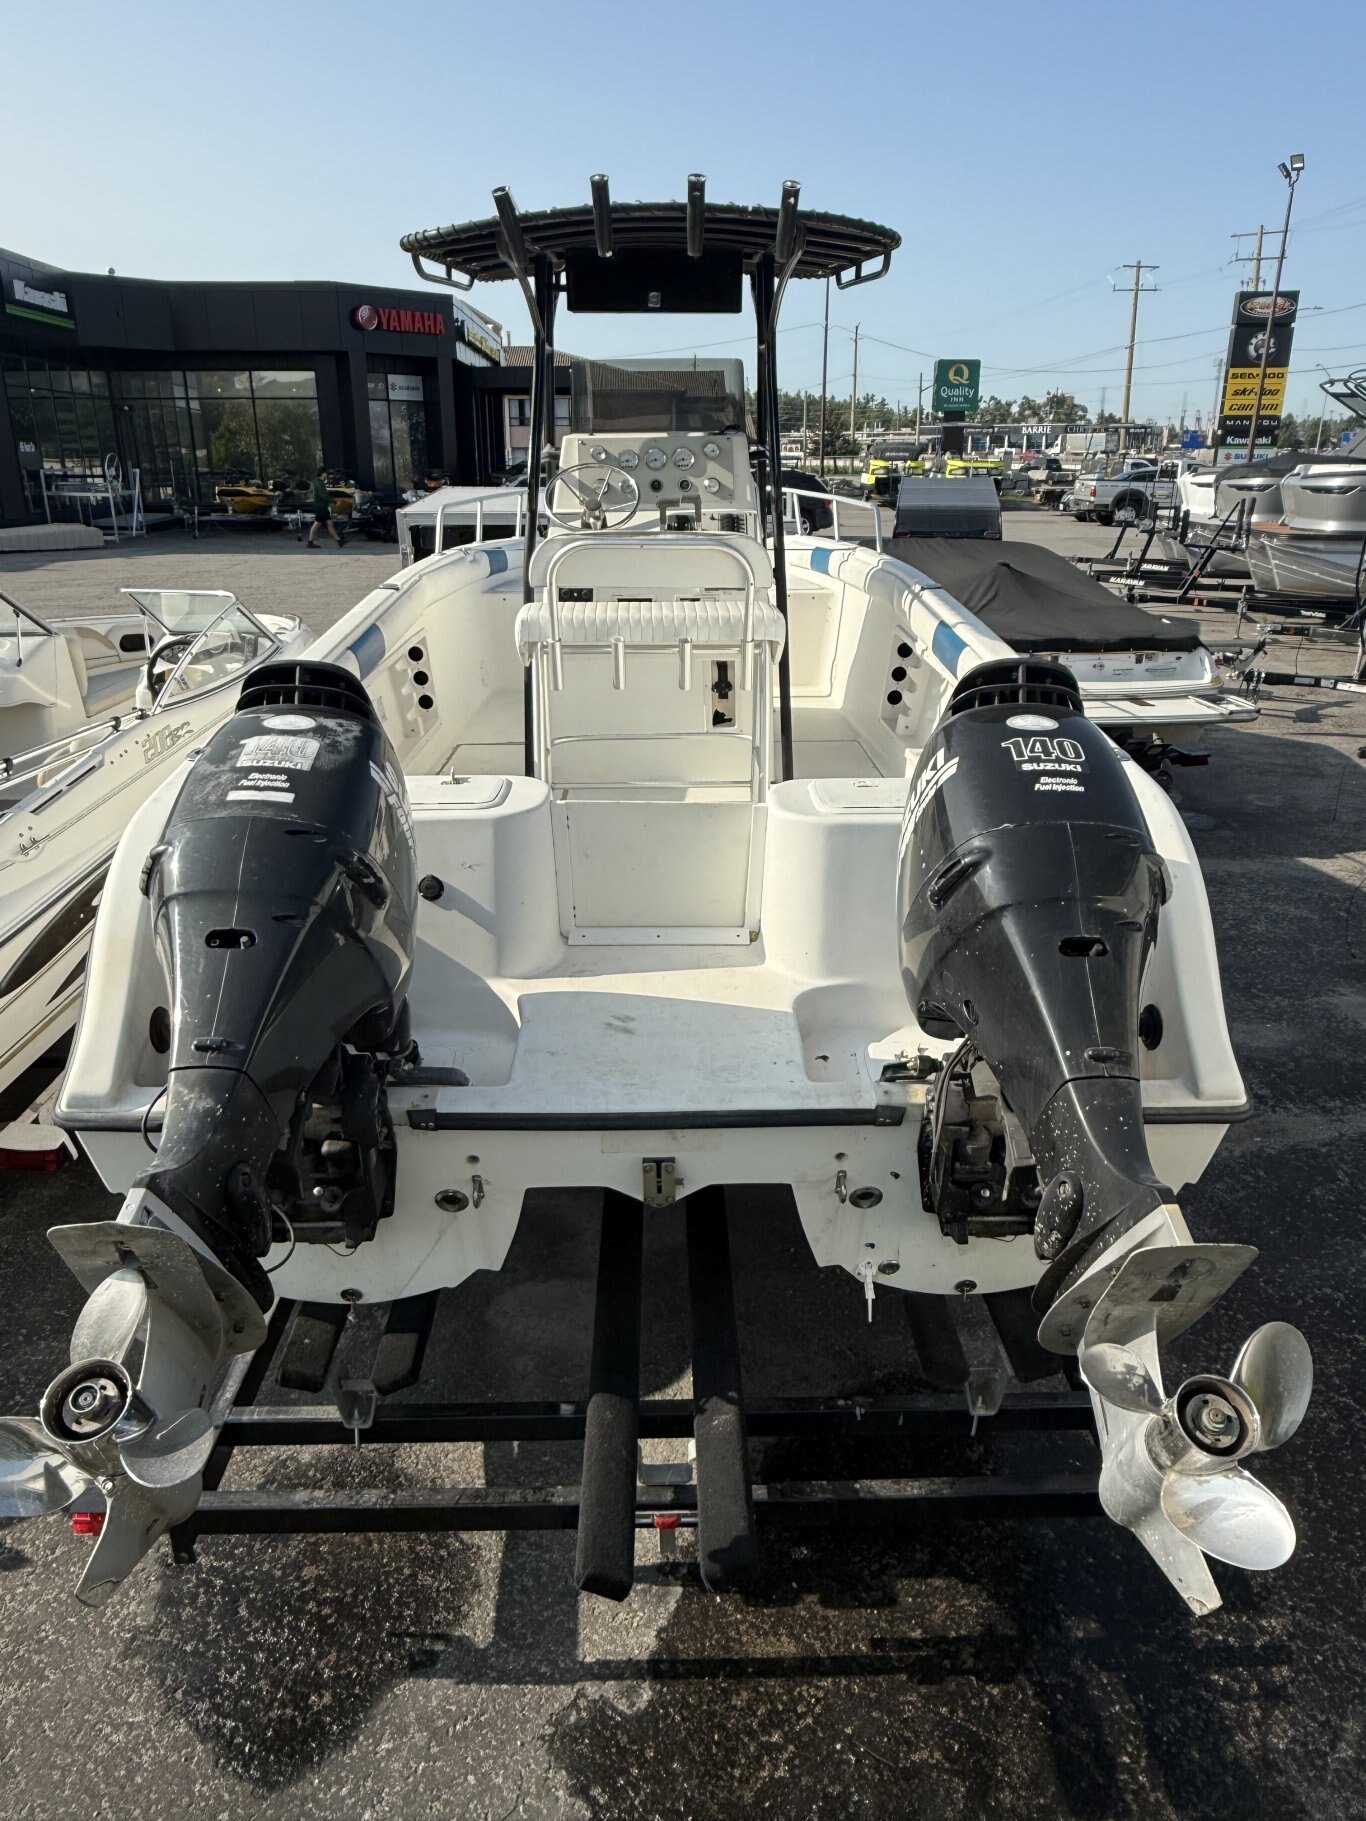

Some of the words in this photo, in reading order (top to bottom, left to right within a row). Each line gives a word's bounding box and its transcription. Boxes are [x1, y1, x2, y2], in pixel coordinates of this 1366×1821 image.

[378, 307, 446, 335] YAMAHA
[949, 363, 970, 384] Q
[940, 386, 975, 398] Quality
[1021, 425, 1052, 434] BARRIE
[239, 735, 320, 759] 140
[1001, 737, 1085, 761] 140
[238, 759, 304, 770] SUZUKI
[1021, 762, 1082, 772] SUZUKI
[256, 780, 291, 788] Injection
[1040, 776, 1078, 784] Electronic
[1034, 783, 1052, 791] Fuel
[1052, 784, 1085, 792] Injection
